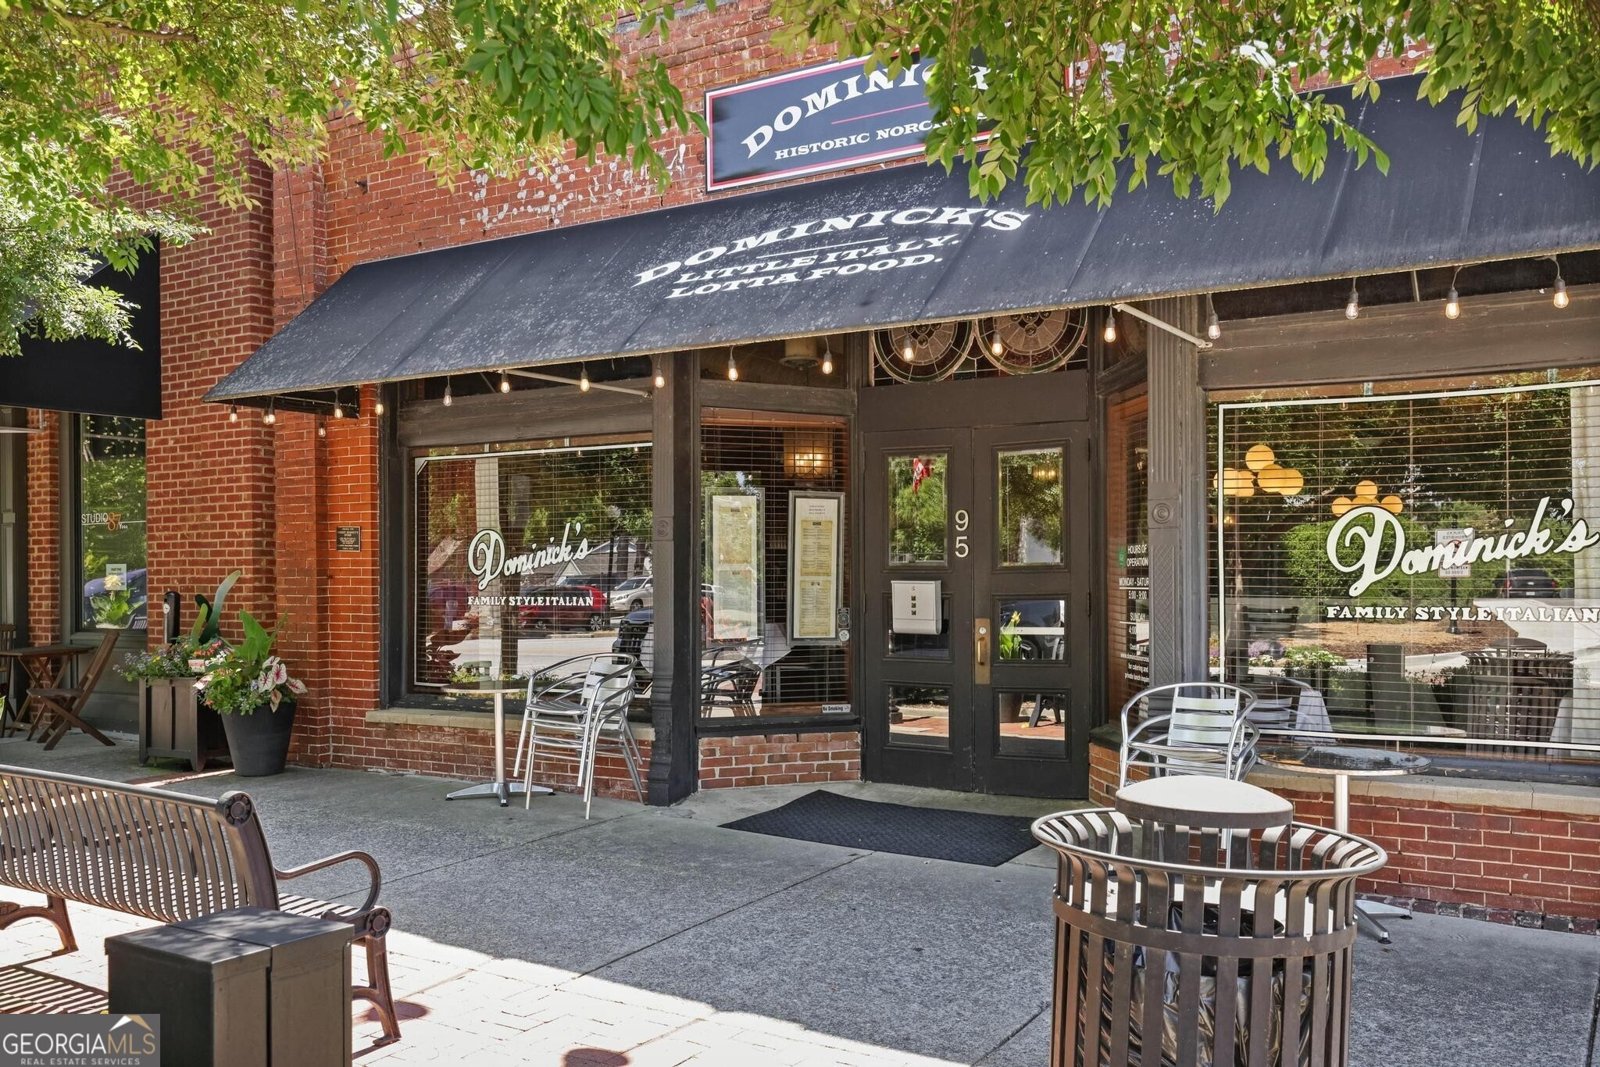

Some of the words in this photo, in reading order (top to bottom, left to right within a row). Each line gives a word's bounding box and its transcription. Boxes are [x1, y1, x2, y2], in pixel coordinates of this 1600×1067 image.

[775, 132, 870, 160] HISTORIC
[631, 207, 1031, 288] DOMINICK'S
[674, 255, 818, 284] LITTLE
[820, 234, 961, 264] ITALY.
[664, 272, 801, 299] LOTTA
[803, 254, 943, 281] FOOD.
[81, 512, 109, 524] STUDIO
[468, 522, 594, 591] Dominick's
[1127, 544, 1141, 554] HOURS
[1141, 543, 1147, 553] OF
[1326, 496, 1600, 597] Dominick's
[1126, 557, 1149, 567] OPERATION
[467, 596, 507, 606] FAMILY
[1326, 605, 1409, 620] FAMILY
[1414, 606, 1492, 622] STYLE
[1494, 606, 1599, 623] ITALIAN
